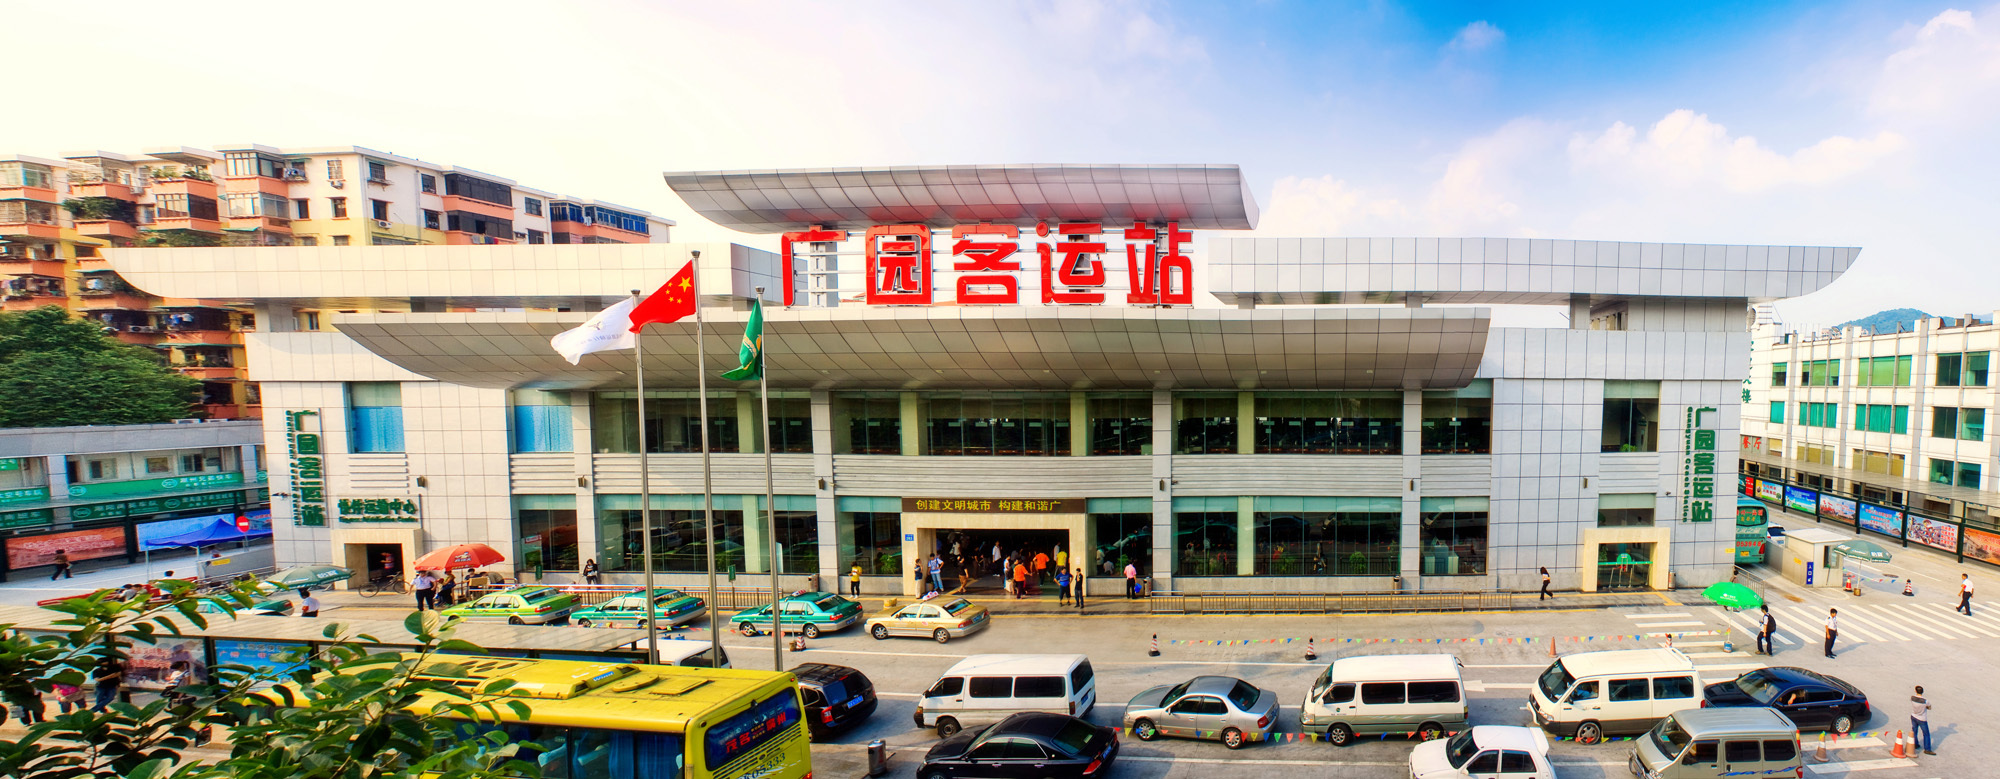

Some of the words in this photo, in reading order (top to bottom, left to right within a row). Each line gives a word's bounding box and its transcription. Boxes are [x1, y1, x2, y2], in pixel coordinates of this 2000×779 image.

[780, 221, 1194, 306] 广园客运站
[1685, 406, 1693, 456] Guangyuan
[293, 410, 325, 526] 广园客运站
[1684, 458, 1692, 487] Coach
[1691, 406, 1717, 522] 广园客运站
[916, 499, 992, 511] 创建文明城市
[998, 499, 1062, 511] 构建和谐广
[1682, 489, 1690, 522] Station
[726, 732, 751, 754] 茂名
